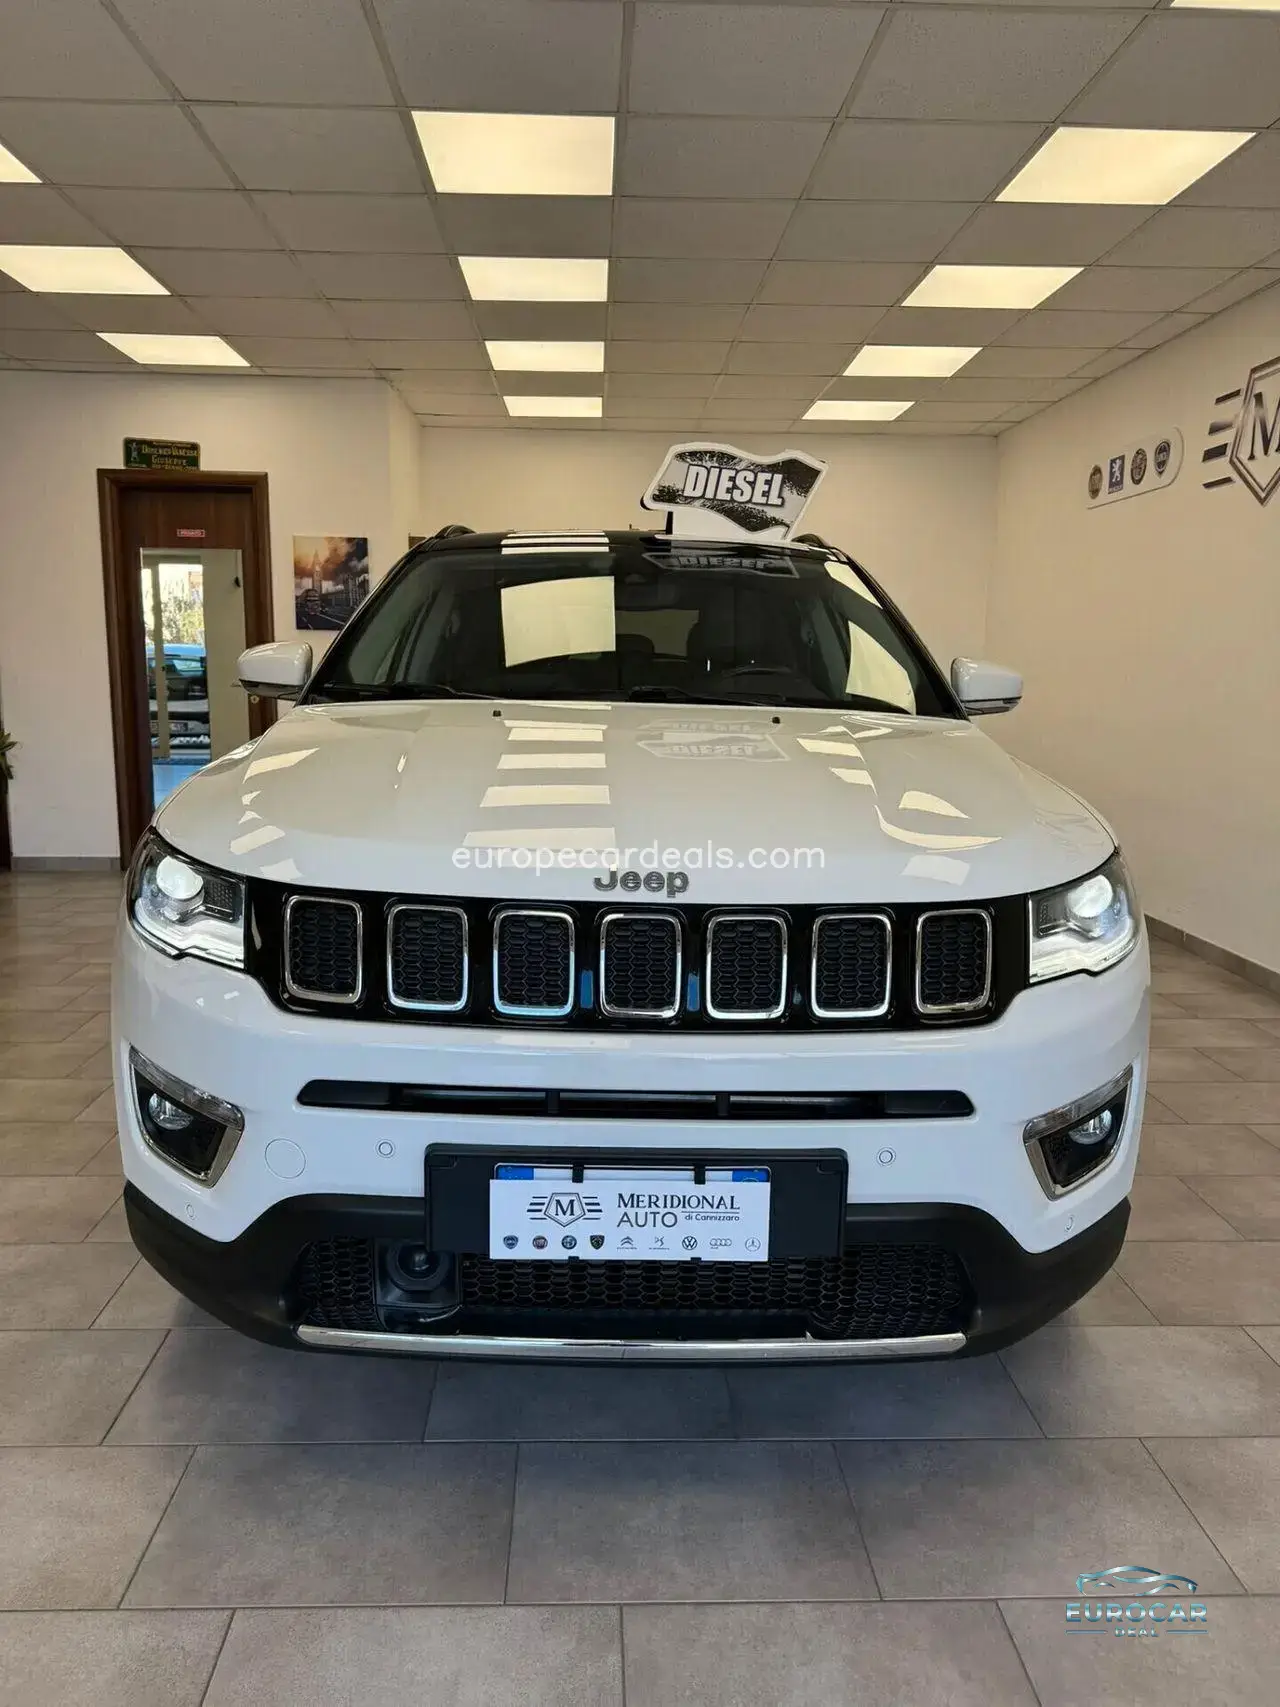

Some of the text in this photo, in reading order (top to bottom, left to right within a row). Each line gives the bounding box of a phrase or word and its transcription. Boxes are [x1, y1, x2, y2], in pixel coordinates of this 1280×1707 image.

[683, 465, 785, 507] DIESEL
[593, 866, 690, 898] Jeep
[554, 1199, 576, 1216] M
[617, 1193, 741, 1210] MERIDIONAL
[617, 1211, 678, 1228] AUTO
[695, 1214, 740, 1222] Cannizzaro
